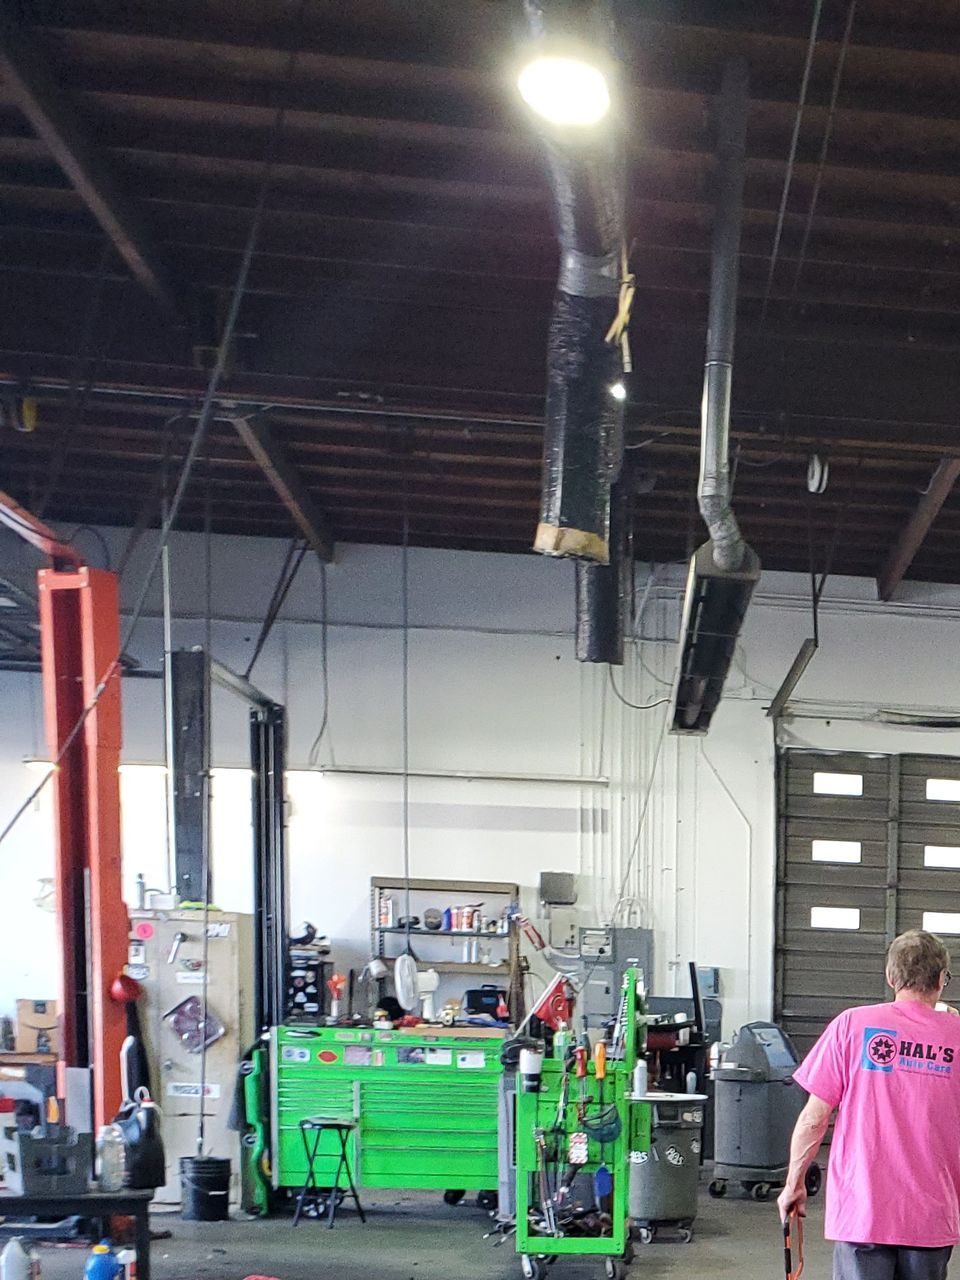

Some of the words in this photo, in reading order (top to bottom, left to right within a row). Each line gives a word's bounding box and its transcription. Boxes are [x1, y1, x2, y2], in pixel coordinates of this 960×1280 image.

[899, 1040, 954, 1063] HAL'S
[899, 1057, 924, 1068] Auto
[927, 1060, 951, 1073] Care
